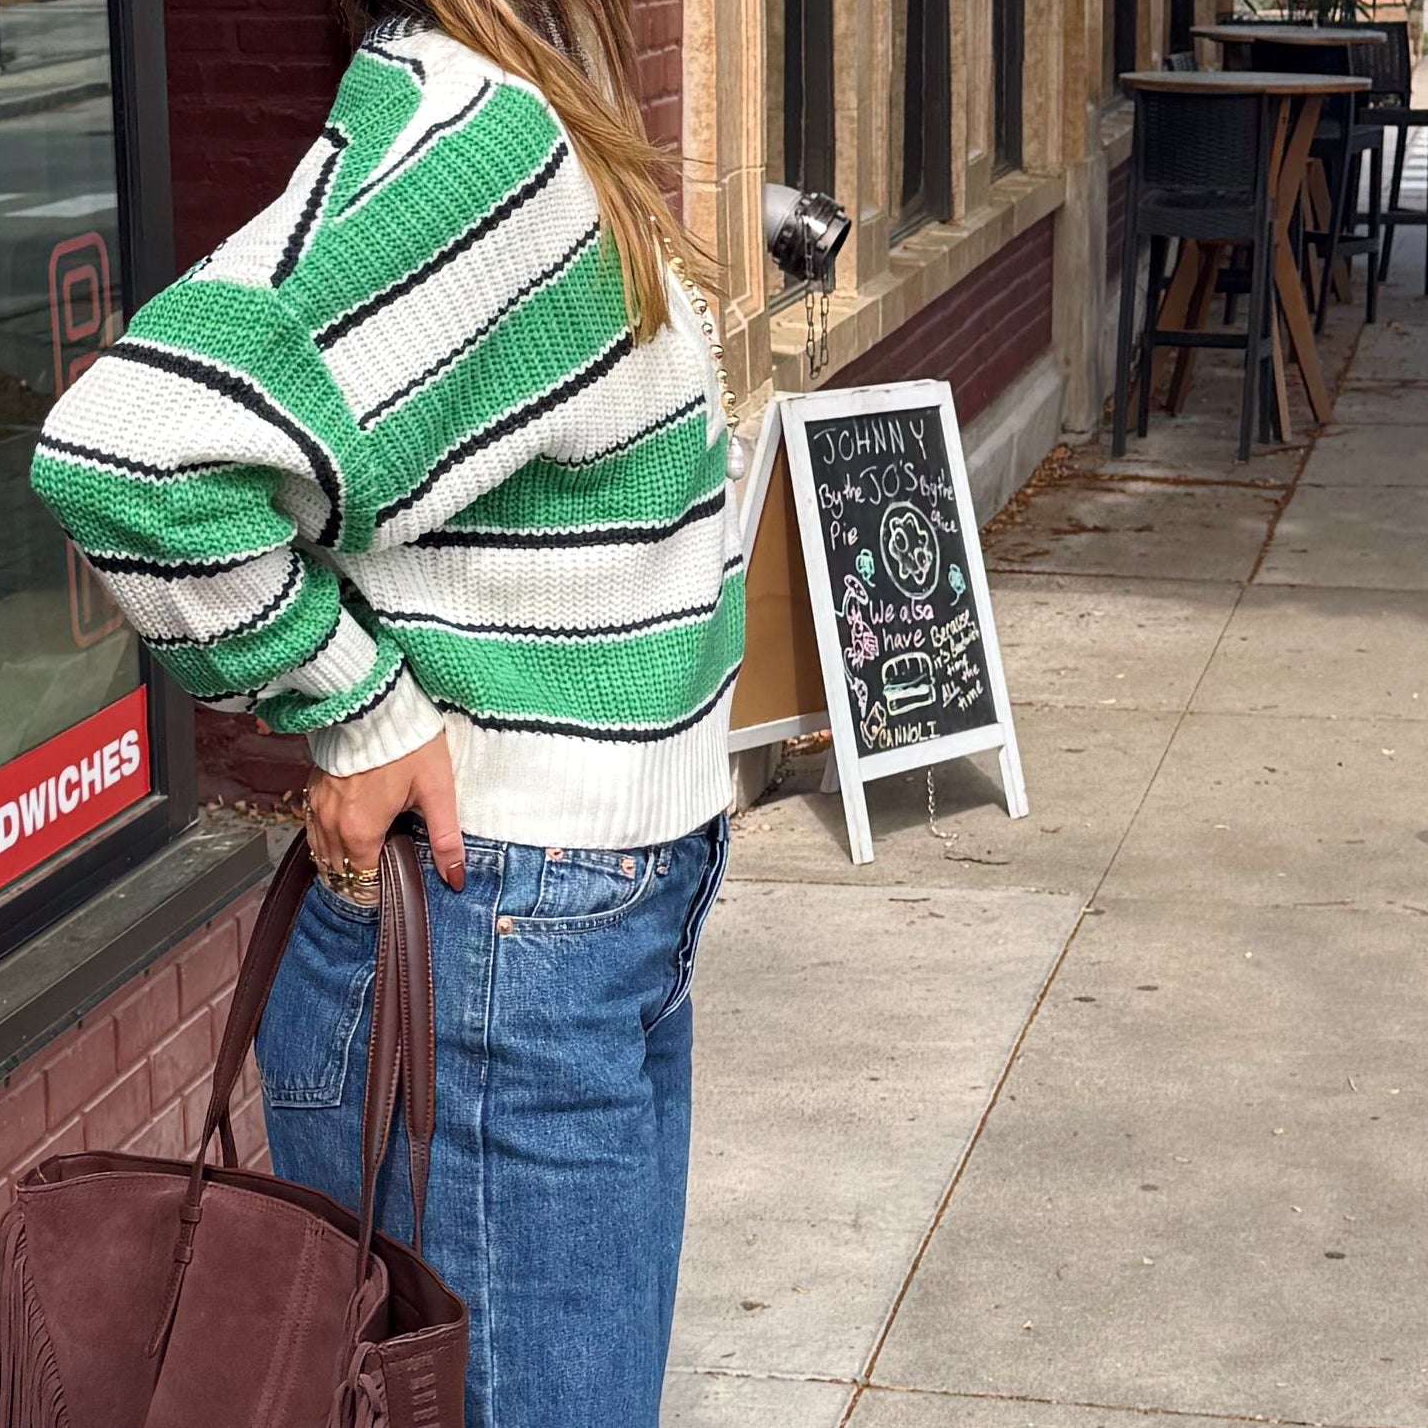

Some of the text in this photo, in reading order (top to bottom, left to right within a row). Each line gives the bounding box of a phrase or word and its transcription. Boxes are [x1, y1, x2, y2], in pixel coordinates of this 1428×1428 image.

[813, 418, 927, 464] JOHNNY
[819, 473, 865, 520] By the
[860, 460, 919, 505] JO'S
[920, 475, 937, 507] By
[830, 520, 860, 551] Pie
[869, 598, 935, 625] We also
[882, 628, 926, 652] have
[958, 680, 984, 711] time
[878, 720, 940, 749] CANNOLI
